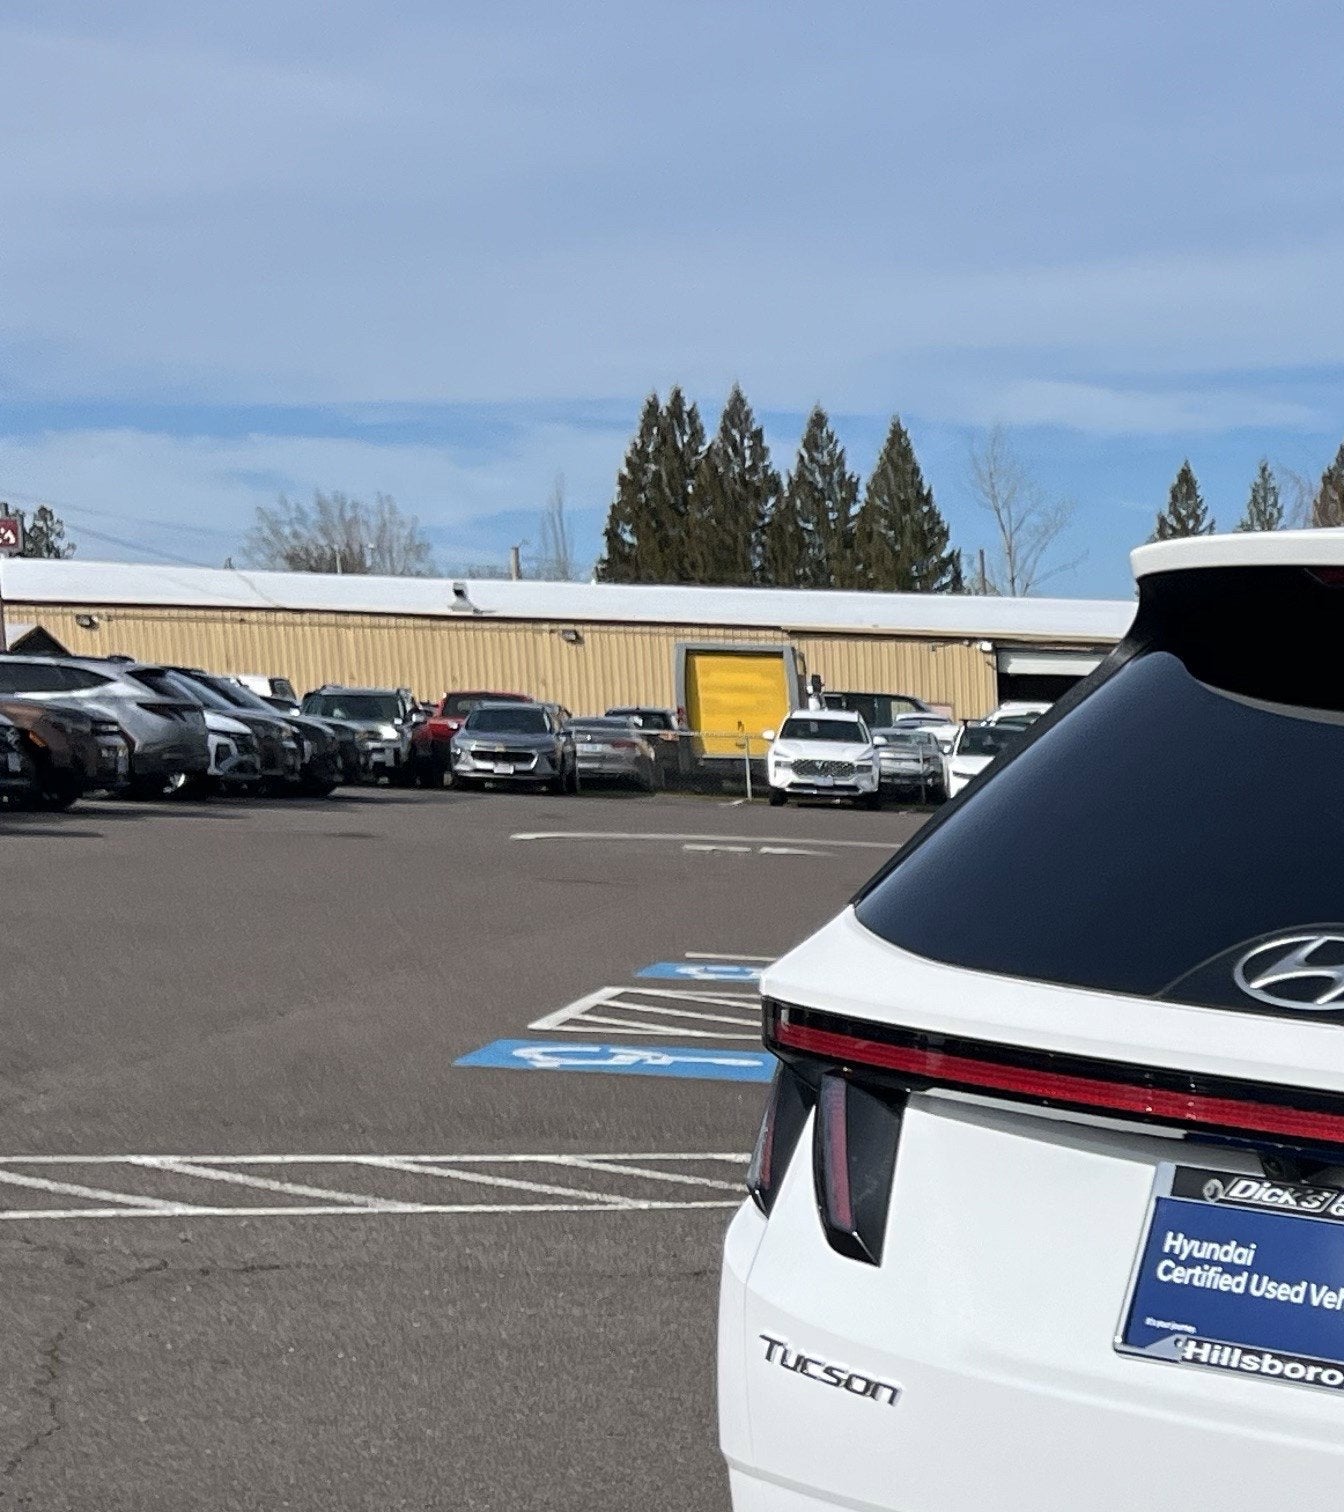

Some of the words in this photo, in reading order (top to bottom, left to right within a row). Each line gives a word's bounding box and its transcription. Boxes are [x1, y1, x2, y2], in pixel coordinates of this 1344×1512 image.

[1163, 1231, 1257, 1266] Hyundai
[1156, 1259, 1249, 1294] Certified
[1250, 1274, 1308, 1304] Used
[1183, 1340, 1344, 1386] Hillsboro
